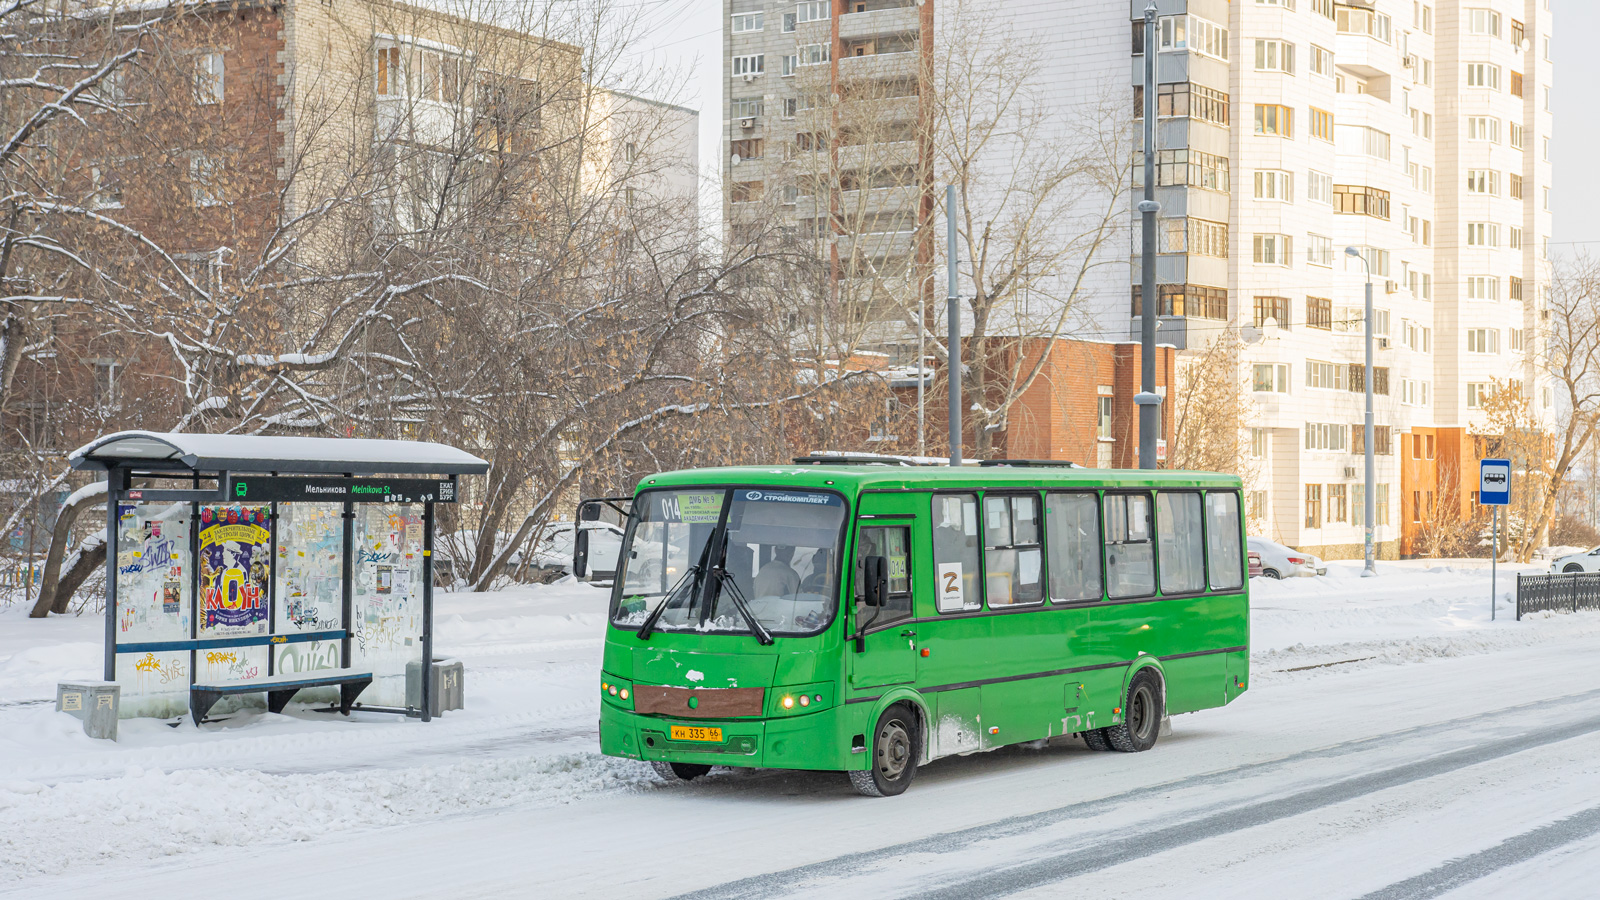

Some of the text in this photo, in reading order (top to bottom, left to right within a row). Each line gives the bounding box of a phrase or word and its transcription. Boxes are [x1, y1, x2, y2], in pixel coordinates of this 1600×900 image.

[305, 484, 346, 494] Мельникова
[352, 484, 392, 494] Melnikova St.
[702, 496, 710, 504] №
[710, 496, 715, 504] 9
[763, 494, 829, 504] СТРОЙКОМПЛЕКТ
[662, 498, 680, 520] 014
[214, 526, 256, 535] ЗАКЛЮЧИТЕЛЬНЫЕ
[215, 531, 238, 540] ГАСТРОЛИ
[239, 530, 254, 540] ЦИРКА
[259, 530, 266, 539] 15
[202, 532, 212, 540] 24
[891, 560, 905, 576] 014
[944, 572, 959, 593] Z
[674, 728, 718, 739] КН 335 66
